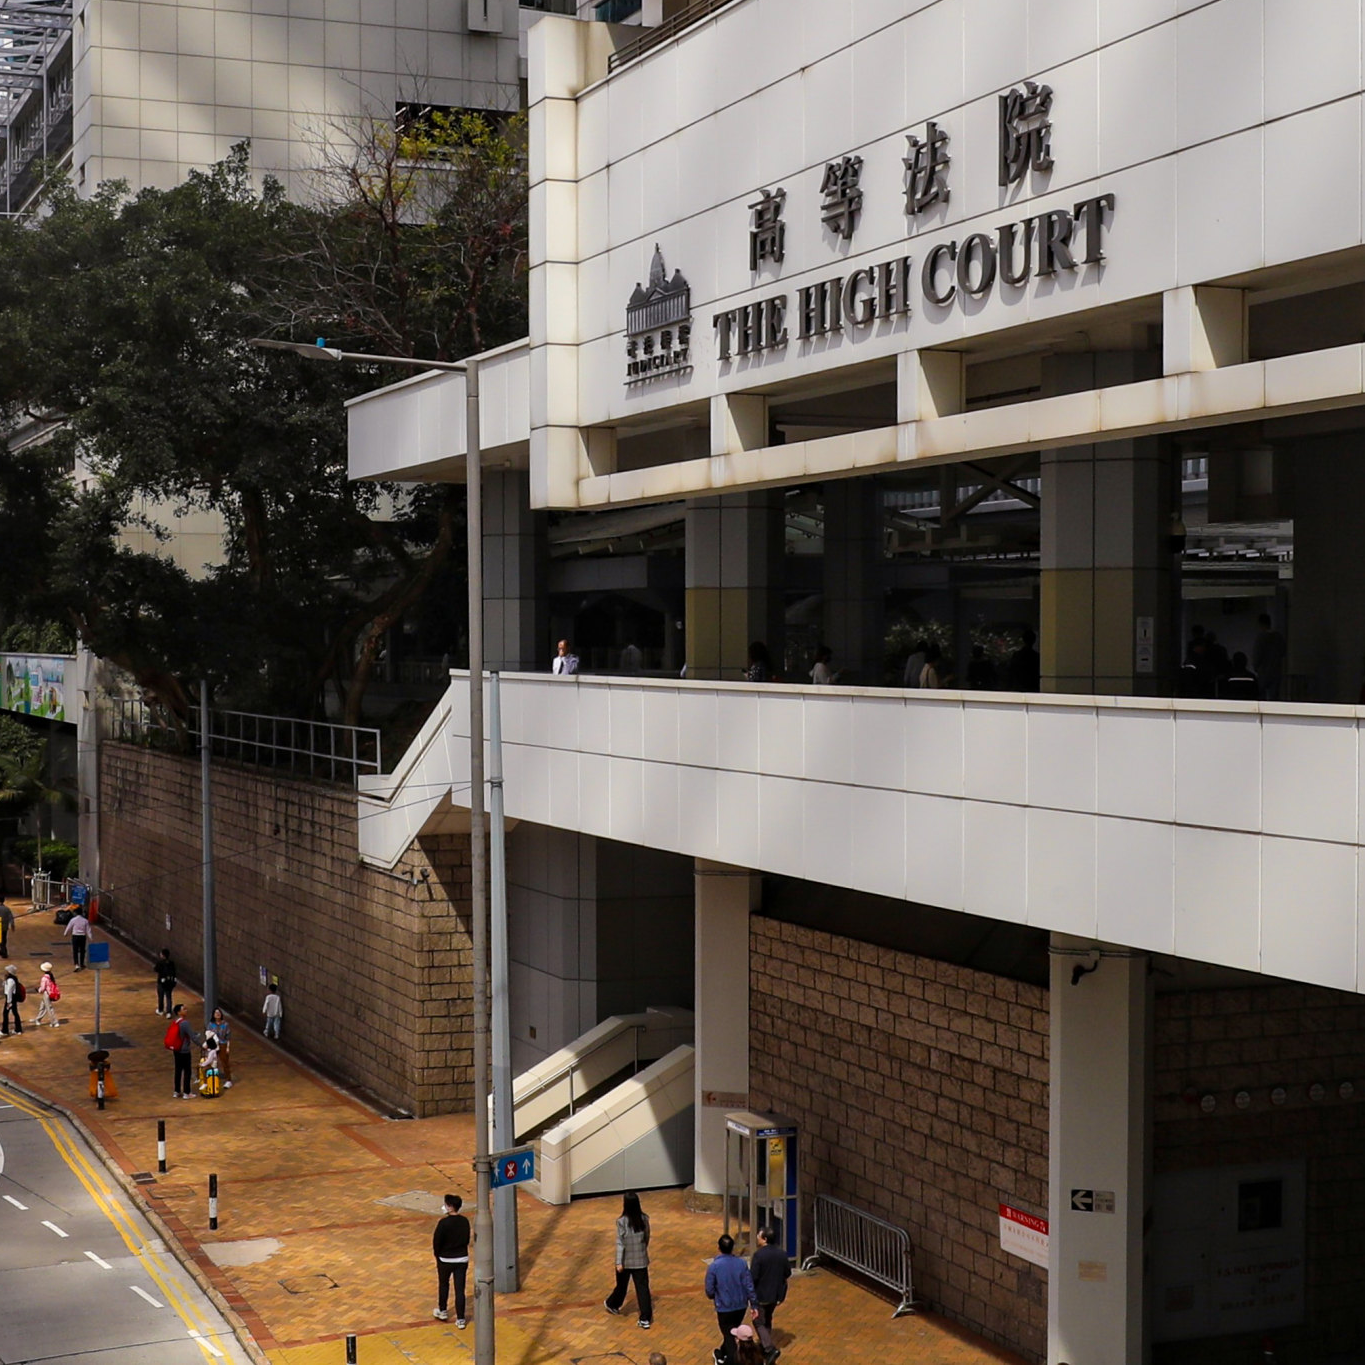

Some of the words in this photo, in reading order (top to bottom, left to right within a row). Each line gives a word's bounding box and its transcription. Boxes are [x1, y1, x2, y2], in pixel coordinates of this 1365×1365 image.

[747, 81, 1054, 272] 高等法院
[713, 295, 788, 361] THE
[797, 256, 912, 340] HIGH
[921, 193, 1115, 306] COURT
